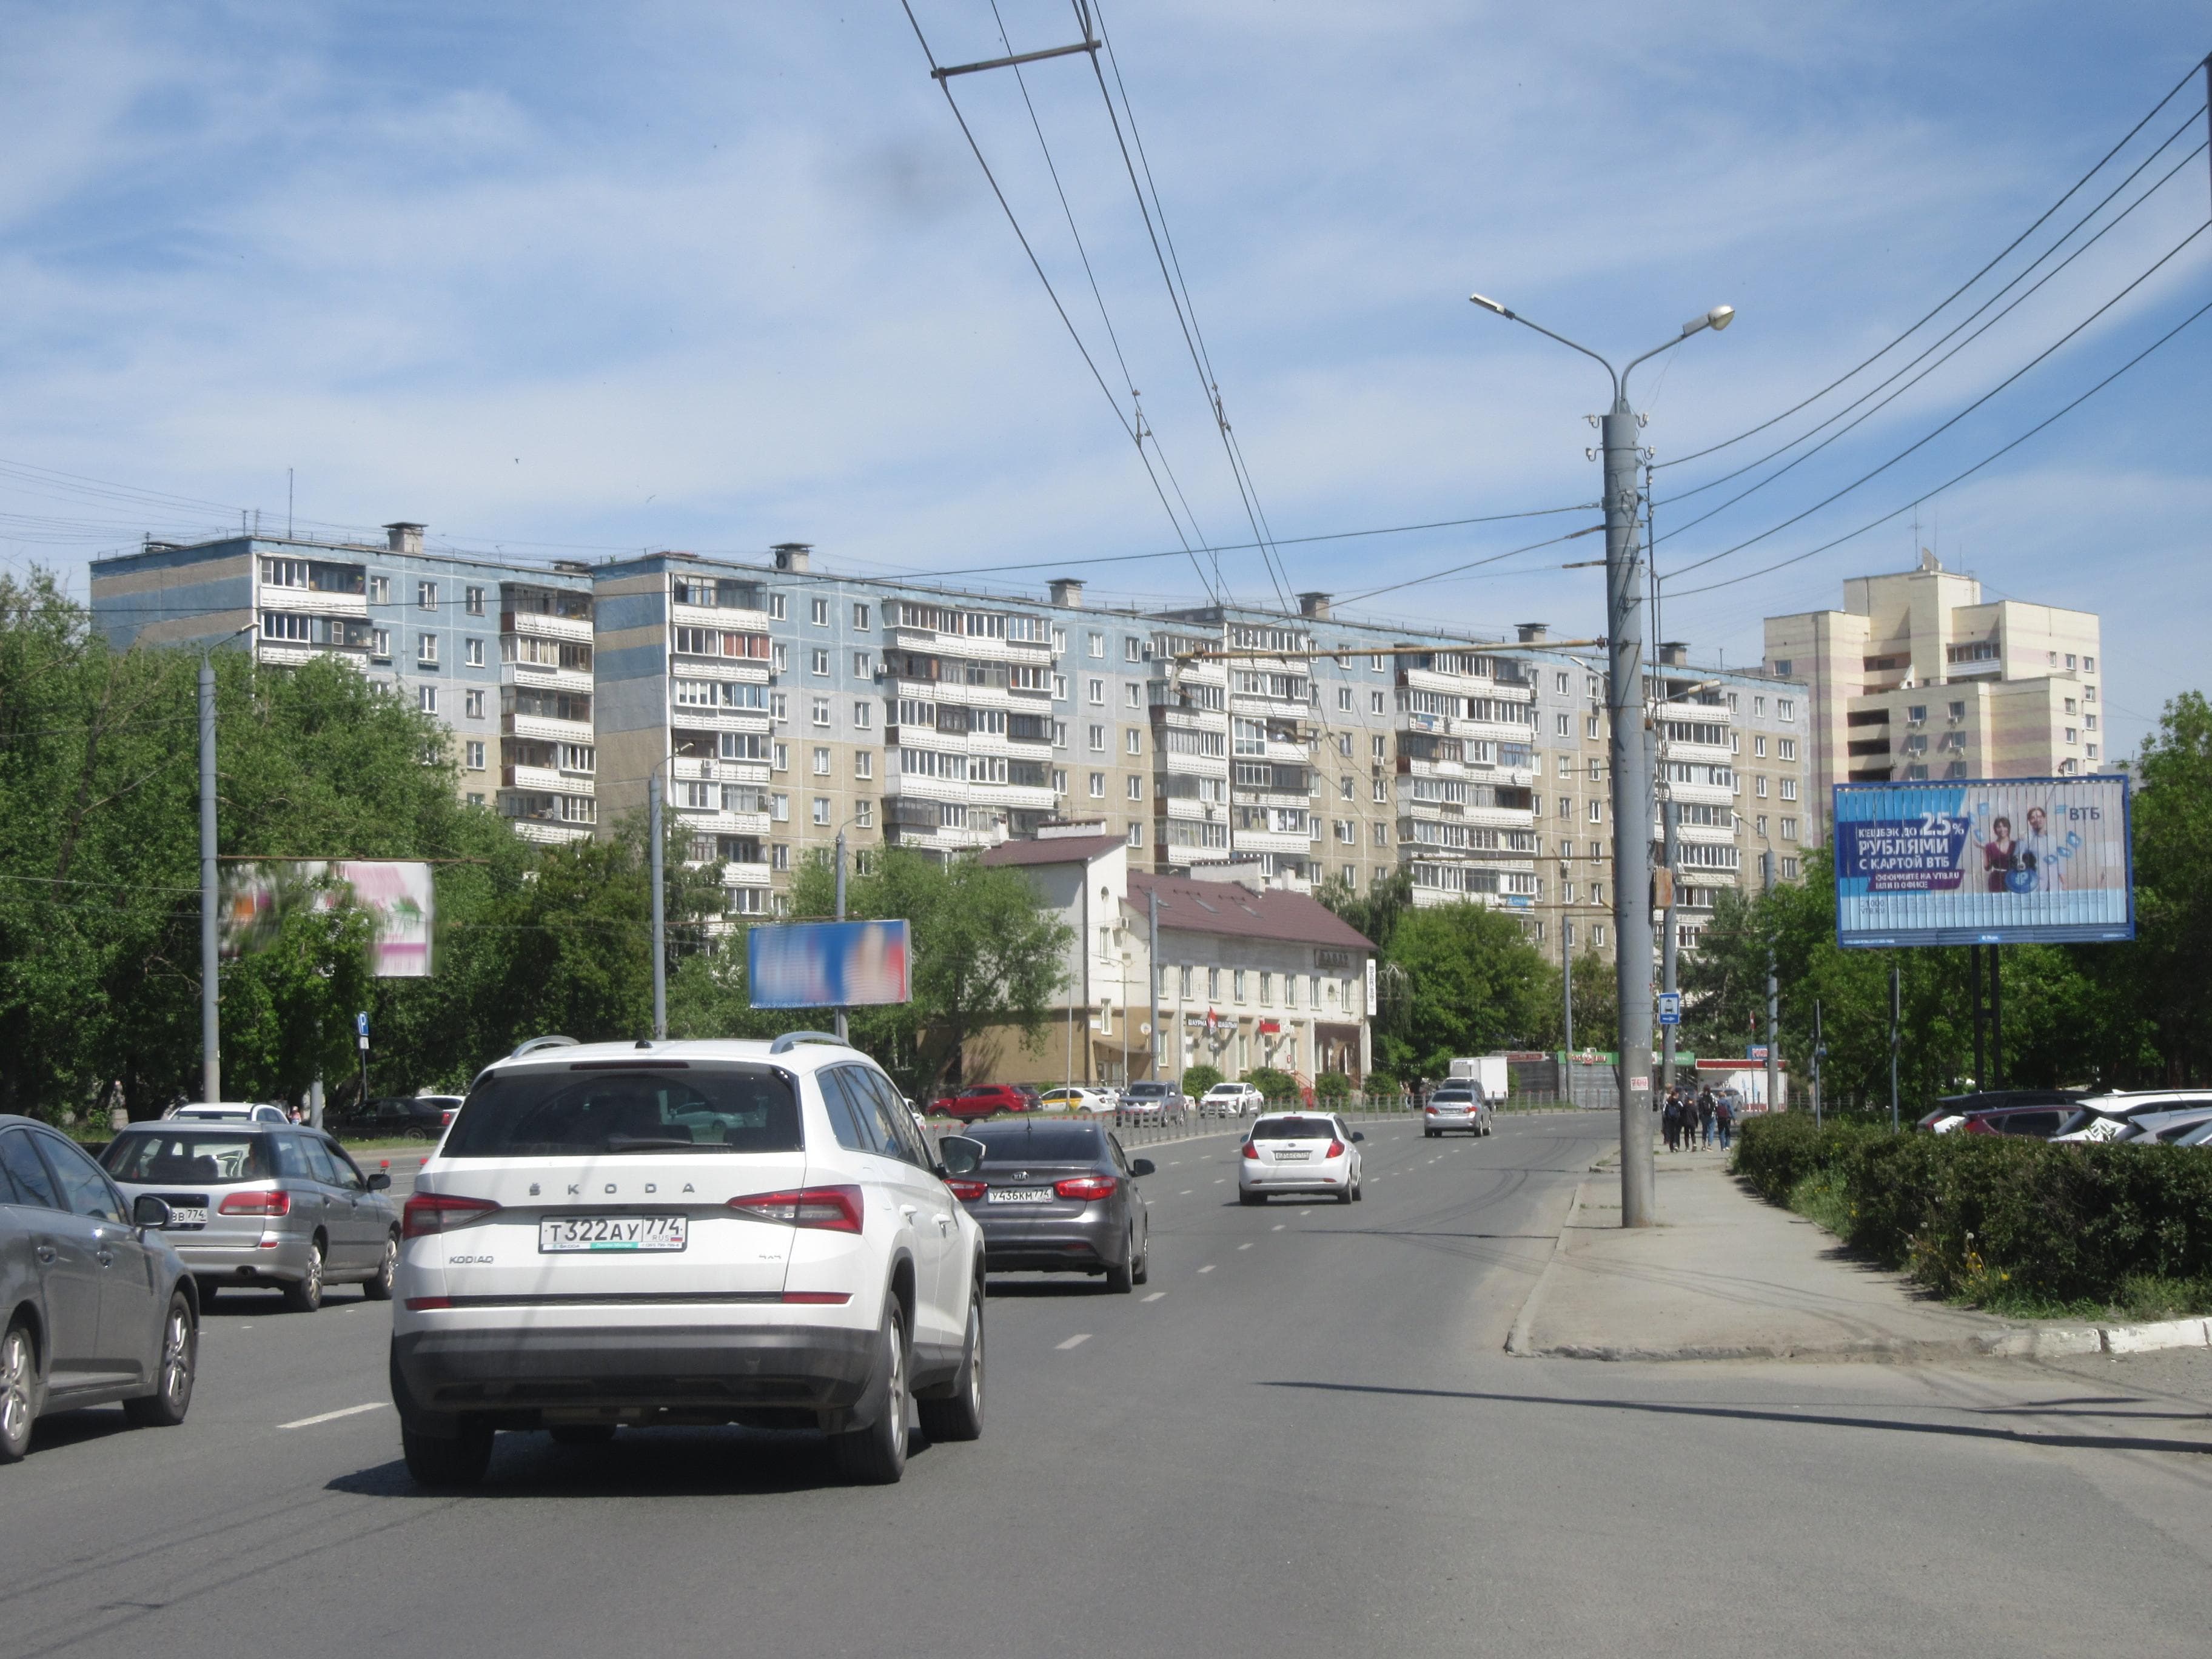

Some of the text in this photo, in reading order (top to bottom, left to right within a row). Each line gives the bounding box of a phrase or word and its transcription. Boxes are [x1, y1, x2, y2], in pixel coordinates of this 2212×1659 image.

[2070, 807, 2100, 820] ВТБ
[1858, 828, 1900, 837] КЕШБЭК
[1902, 827, 1917, 838] ДО
[1858, 838, 1949, 856] РУБЛЯМИ
[1859, 855, 1949, 870] С КАРТОЙ ВТБ
[645, 1217, 679, 1235] 774
[449, 1255, 494, 1264] KODIAQ
